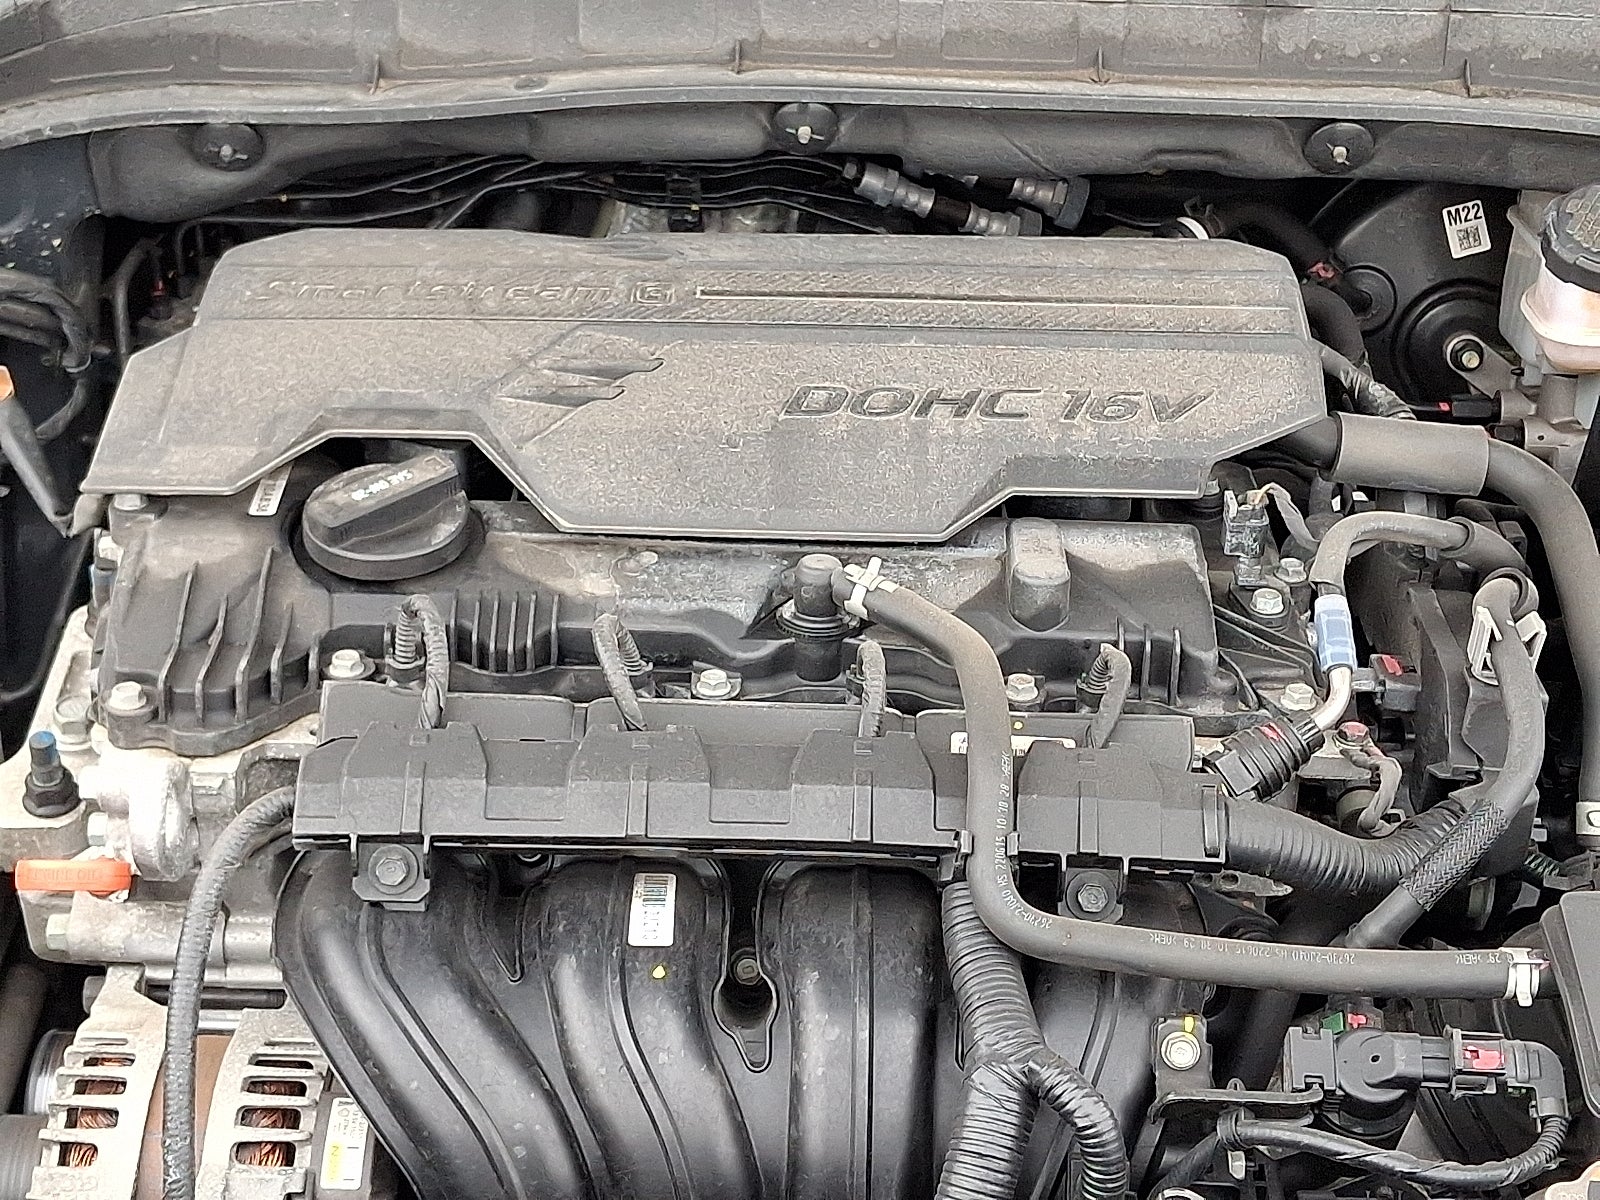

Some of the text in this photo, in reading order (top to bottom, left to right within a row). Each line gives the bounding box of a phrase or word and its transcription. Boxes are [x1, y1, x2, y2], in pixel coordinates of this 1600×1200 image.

[1446, 202, 1483, 227] M22
[778, 385, 1214, 424] DOHC 16V
